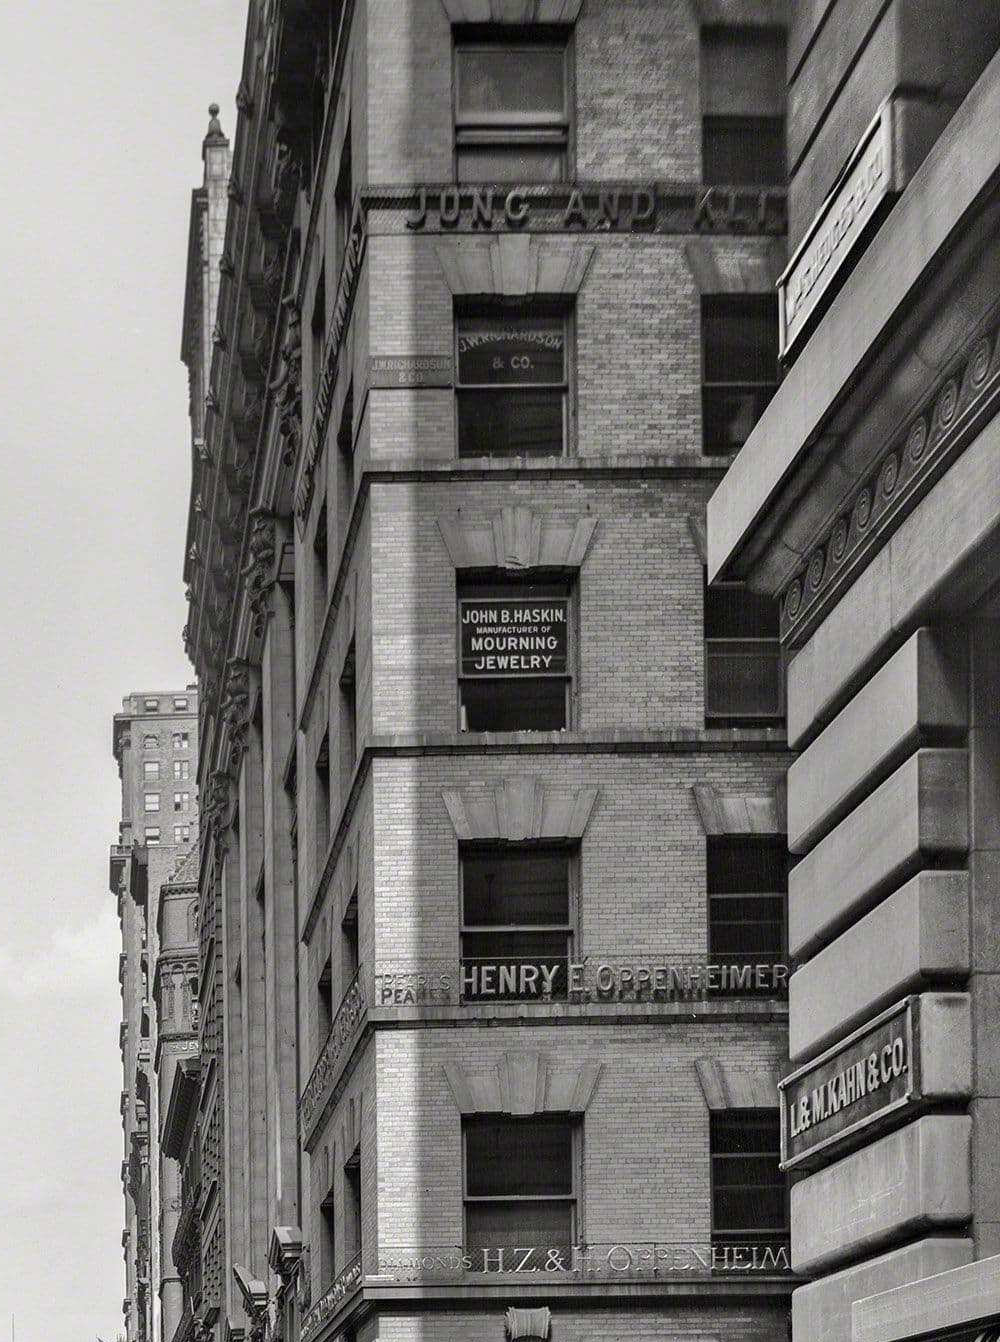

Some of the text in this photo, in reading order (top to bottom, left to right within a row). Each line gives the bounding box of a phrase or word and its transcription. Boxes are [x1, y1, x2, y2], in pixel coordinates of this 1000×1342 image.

[406, 189, 530, 230] JUNG
[563, 189, 656, 230] AND
[511, 356, 535, 369] CO.
[462, 609, 497, 624] JOHN
[476, 626, 552, 635] MANUFACTURER OF
[471, 636, 558, 651] MOURNING
[474, 654, 553, 671] JEWELRY
[461, 965, 560, 995] HENRY
[596, 964, 789, 994] OPPENHEIMER
[544, 1248, 567, 1272] &
